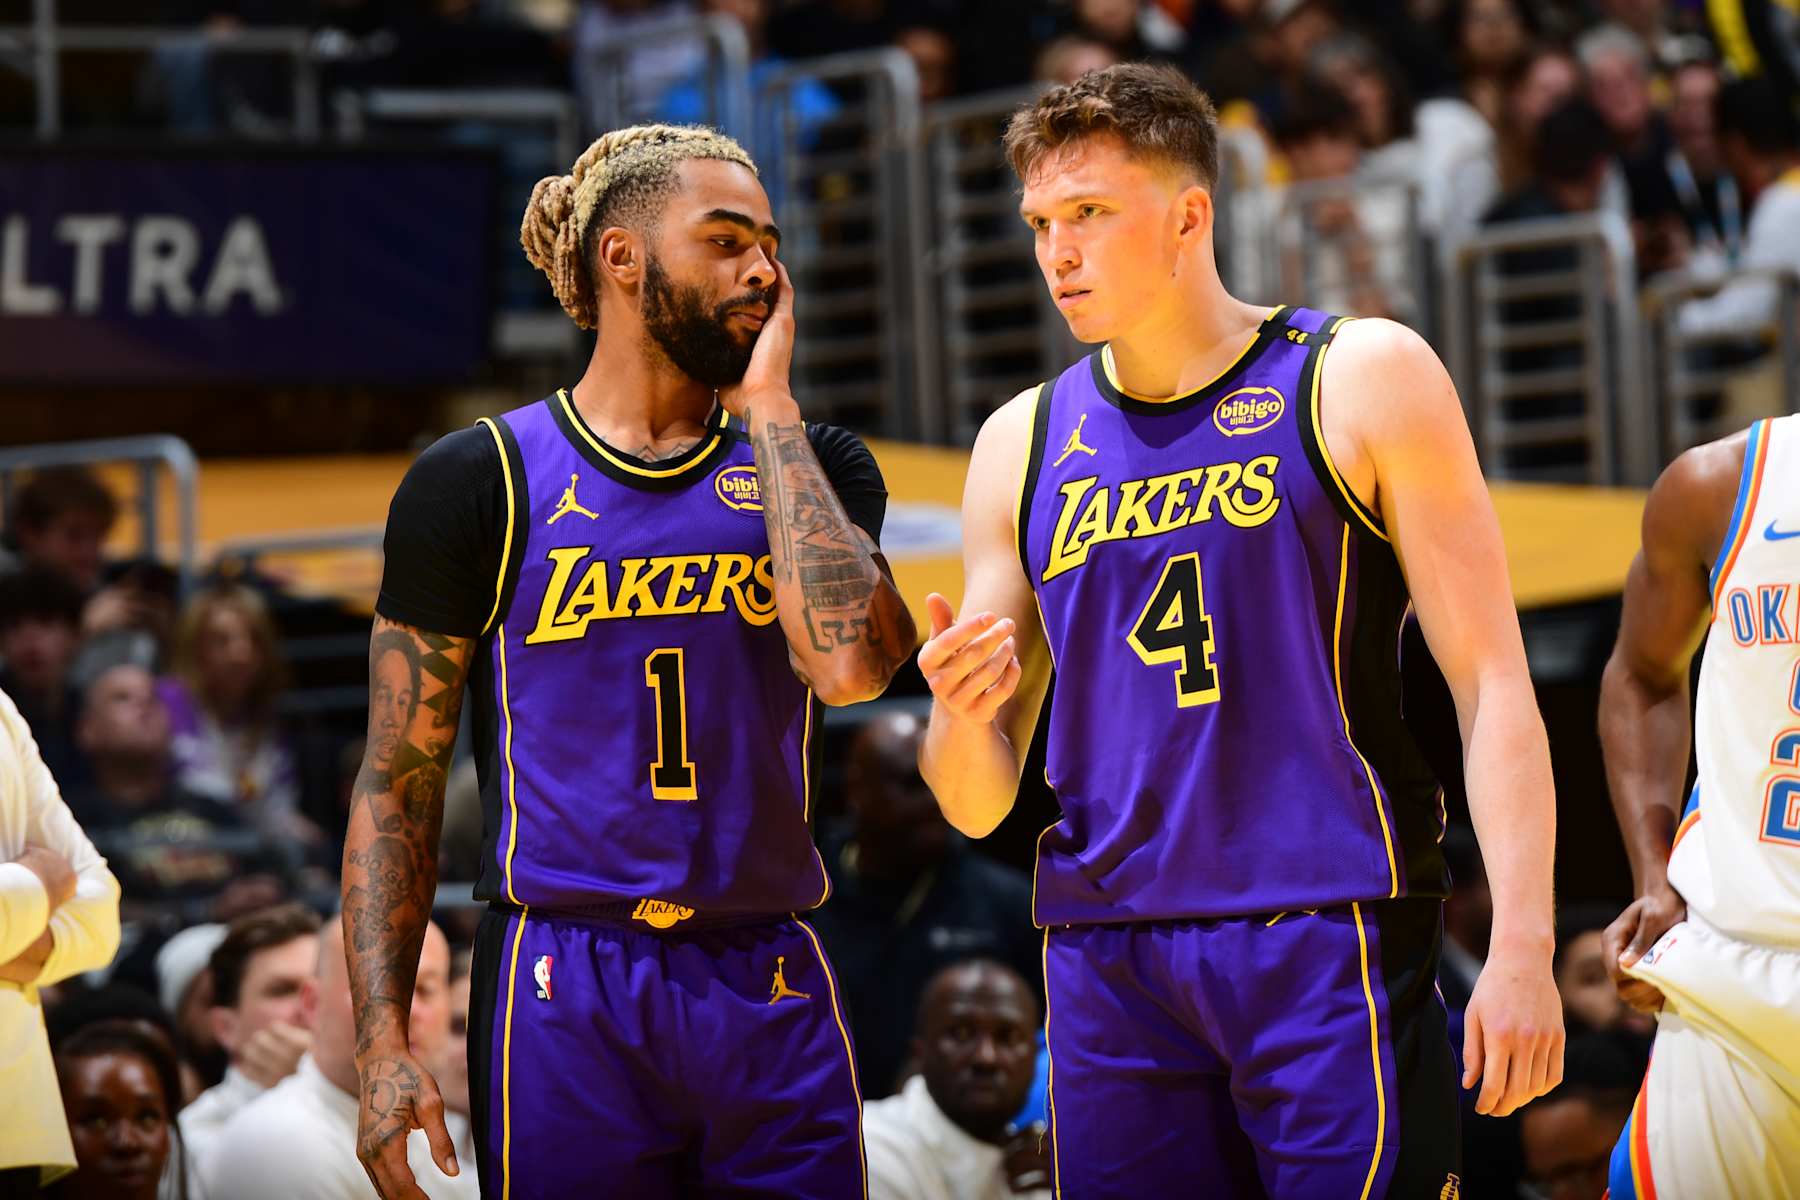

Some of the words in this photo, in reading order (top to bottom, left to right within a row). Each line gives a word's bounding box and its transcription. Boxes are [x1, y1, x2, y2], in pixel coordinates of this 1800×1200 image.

[2, 214, 283, 314] LTRA
[1286, 329, 1308, 344] 44
[1220, 399, 1281, 419] bibigo
[1229, 415, 1255, 426] 비비고
[721, 476, 761, 492] bibi
[1041, 455, 1281, 585] LAKERS
[1126, 552, 1221, 708] 4
[1727, 583, 1800, 648] OK
[645, 648, 698, 801] 1
